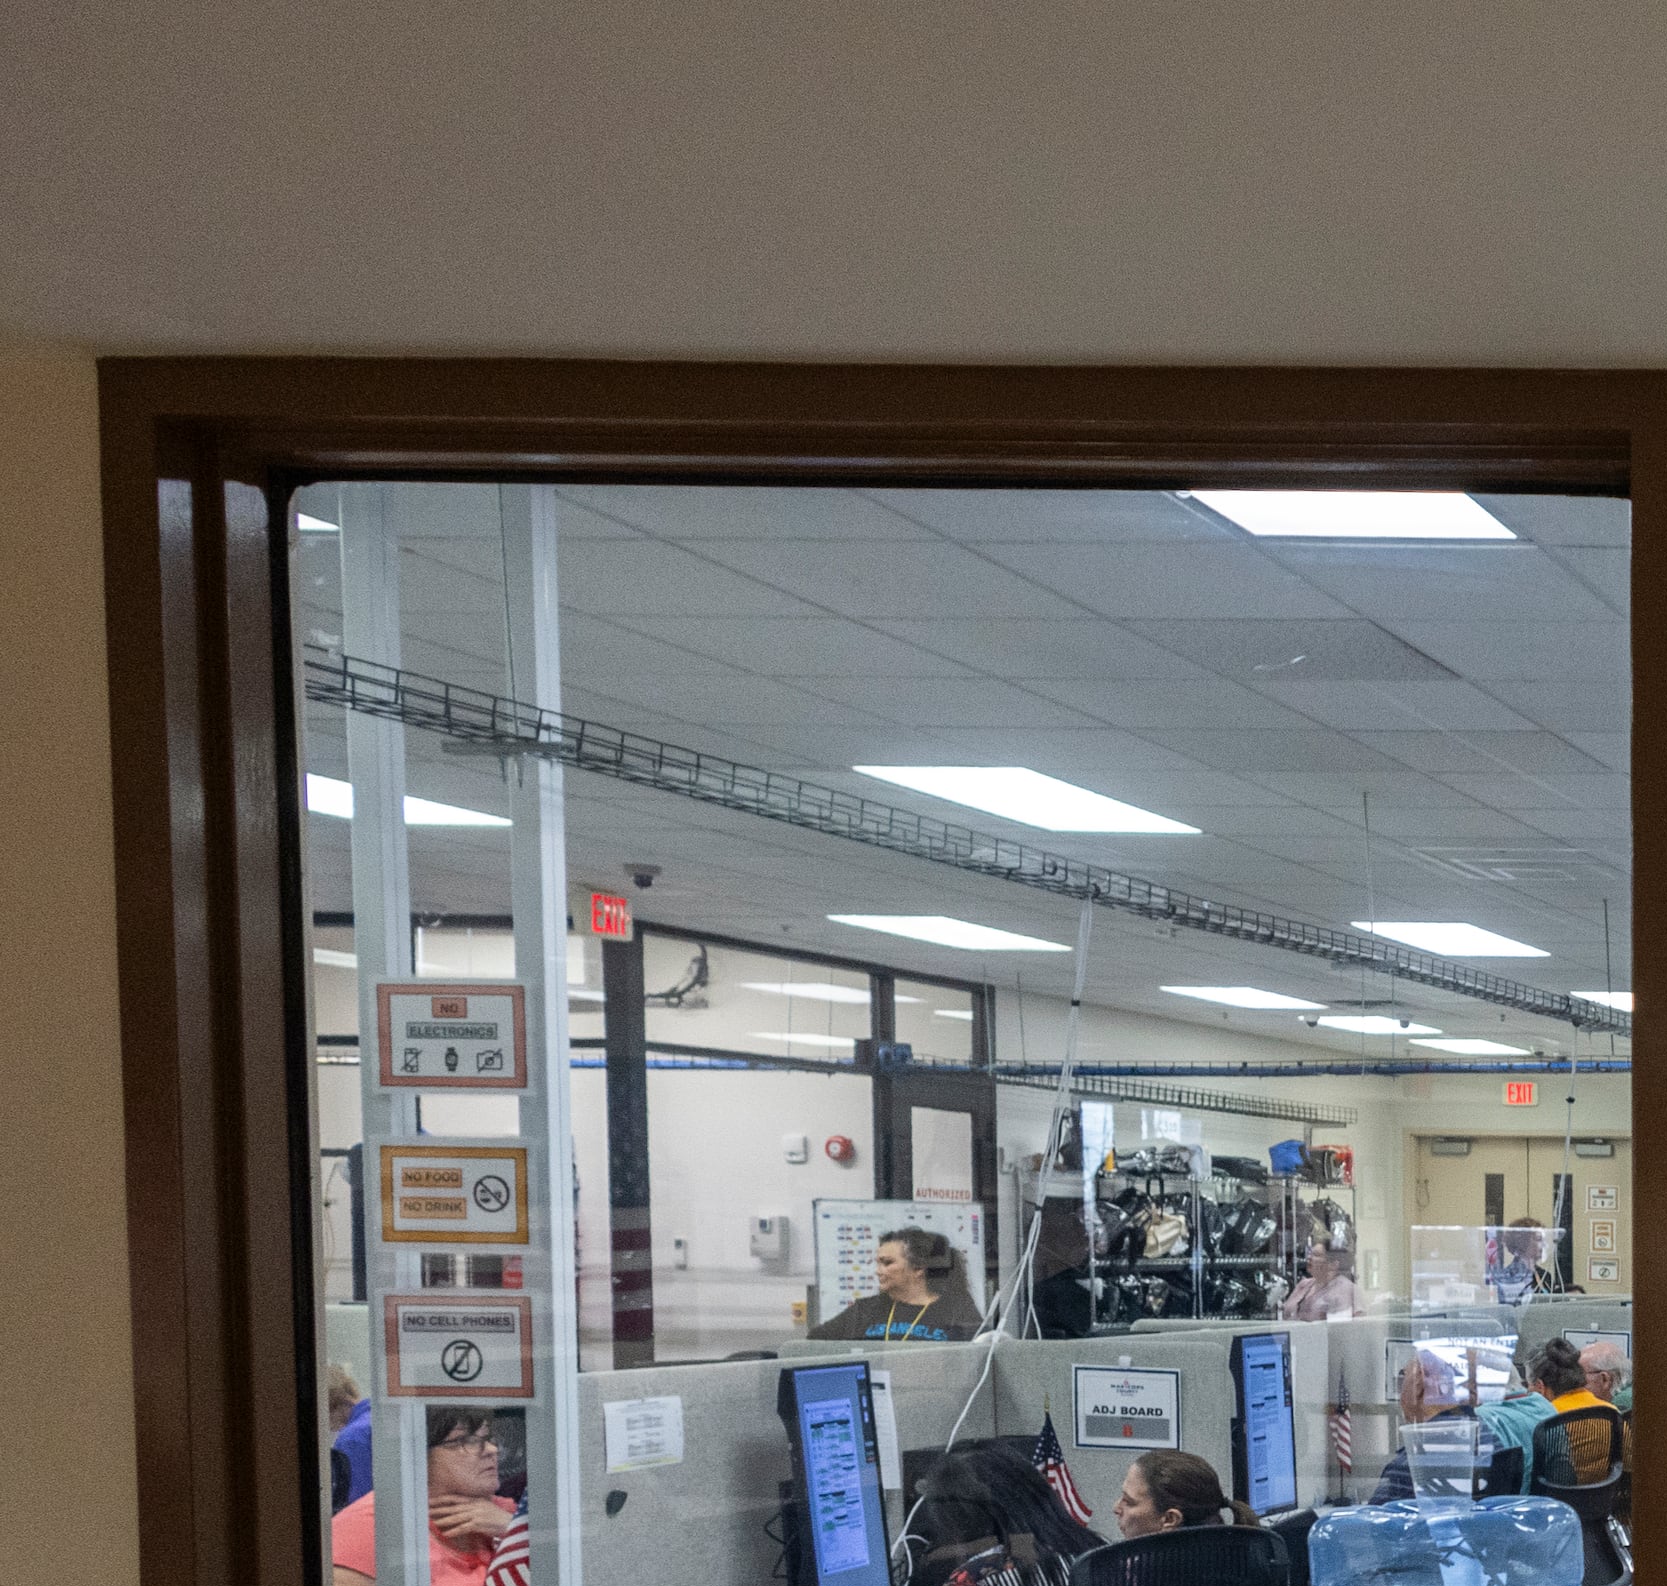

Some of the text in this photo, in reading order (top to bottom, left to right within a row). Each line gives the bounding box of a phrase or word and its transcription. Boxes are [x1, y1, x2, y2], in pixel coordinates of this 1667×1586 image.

[591, 893, 627, 935] EXIT
[440, 1003, 459, 1013] NO
[409, 1025, 494, 1038] ELECTRONICS
[1507, 1082, 1534, 1104] EXIT
[404, 1172, 459, 1182] NO FOOD
[915, 1187, 971, 1200] AUTHORIZED
[403, 1202, 463, 1213] NO DRINK
[406, 1316, 511, 1327] NO CELL PHONES
[1092, 1405, 1163, 1417] ADJ BOARD
